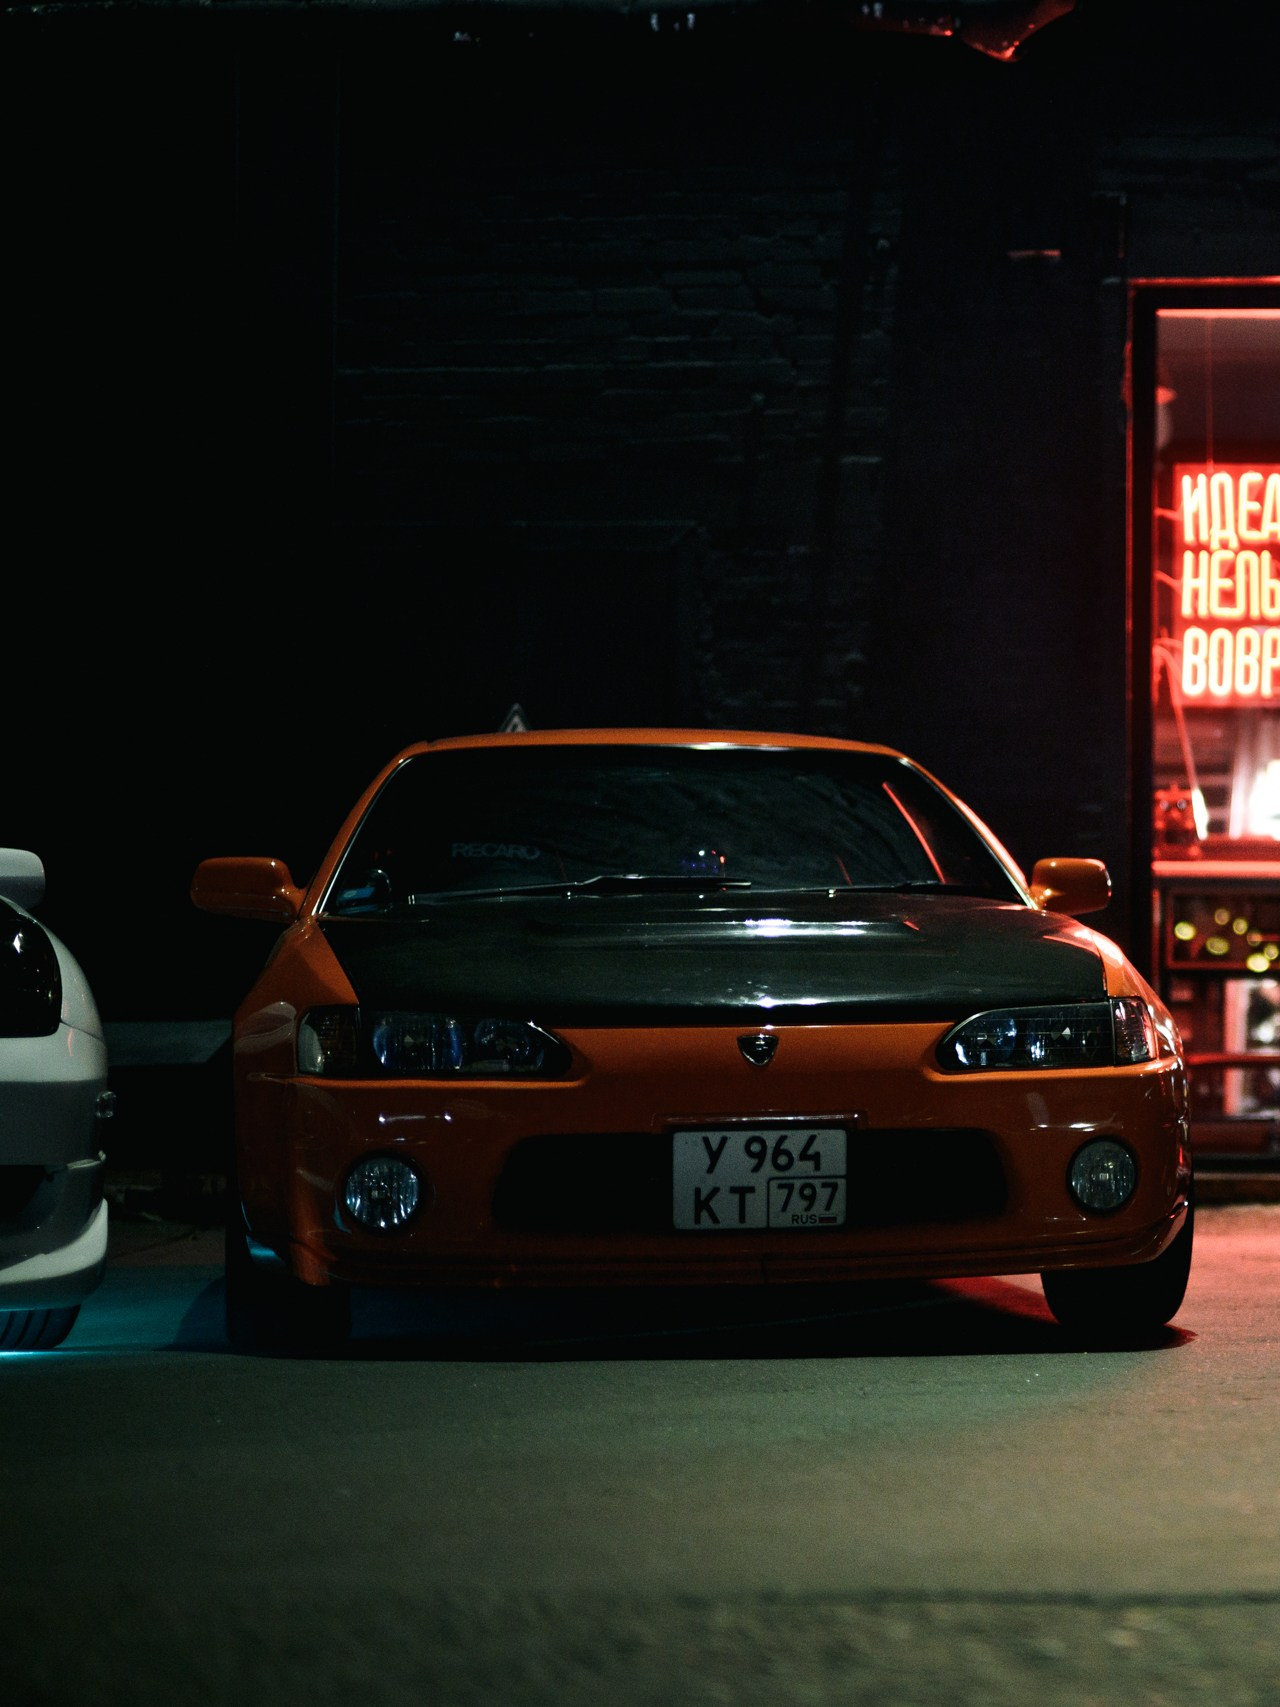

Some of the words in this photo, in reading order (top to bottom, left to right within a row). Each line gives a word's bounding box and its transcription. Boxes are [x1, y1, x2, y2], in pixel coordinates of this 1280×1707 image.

[450, 842, 541, 860] RECARO
[744, 1134, 821, 1173] 964
[777, 1182, 838, 1212] 797
[791, 1215, 817, 1225] RUS
